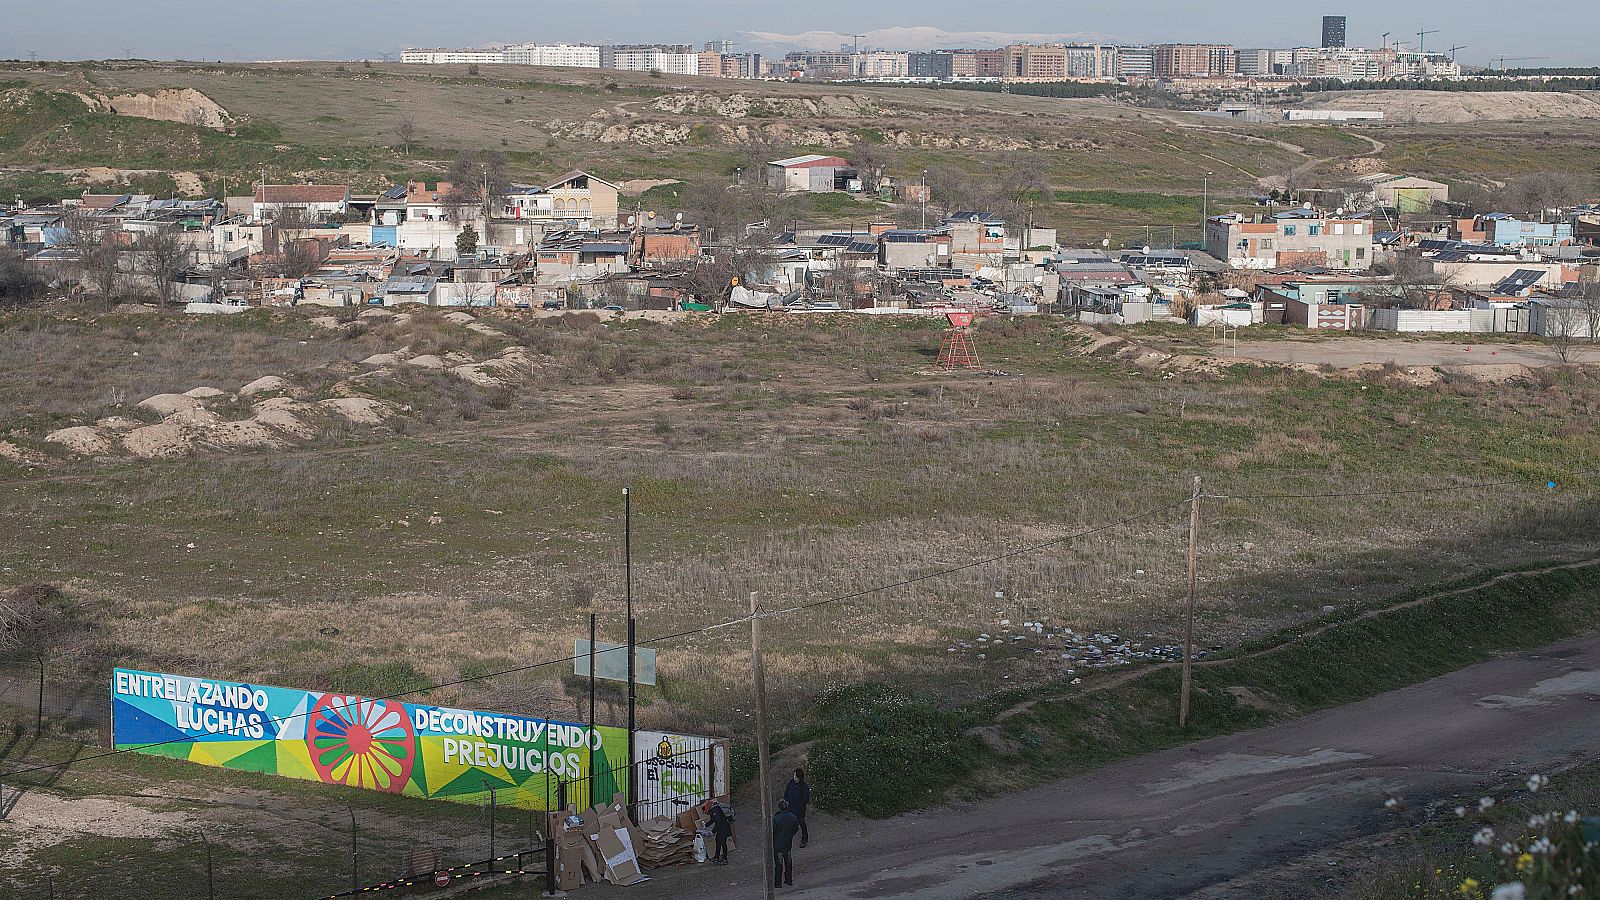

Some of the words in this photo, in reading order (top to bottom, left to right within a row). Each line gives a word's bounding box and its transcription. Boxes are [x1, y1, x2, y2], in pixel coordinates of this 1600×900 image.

[116, 671, 269, 712] ENTRELAZANDO
[175, 704, 264, 739] LUCHAS
[272, 715, 292, 740] Y
[415, 708, 602, 751] DECONSTRUYENDO
[443, 738, 580, 779] PREJUICIOS
